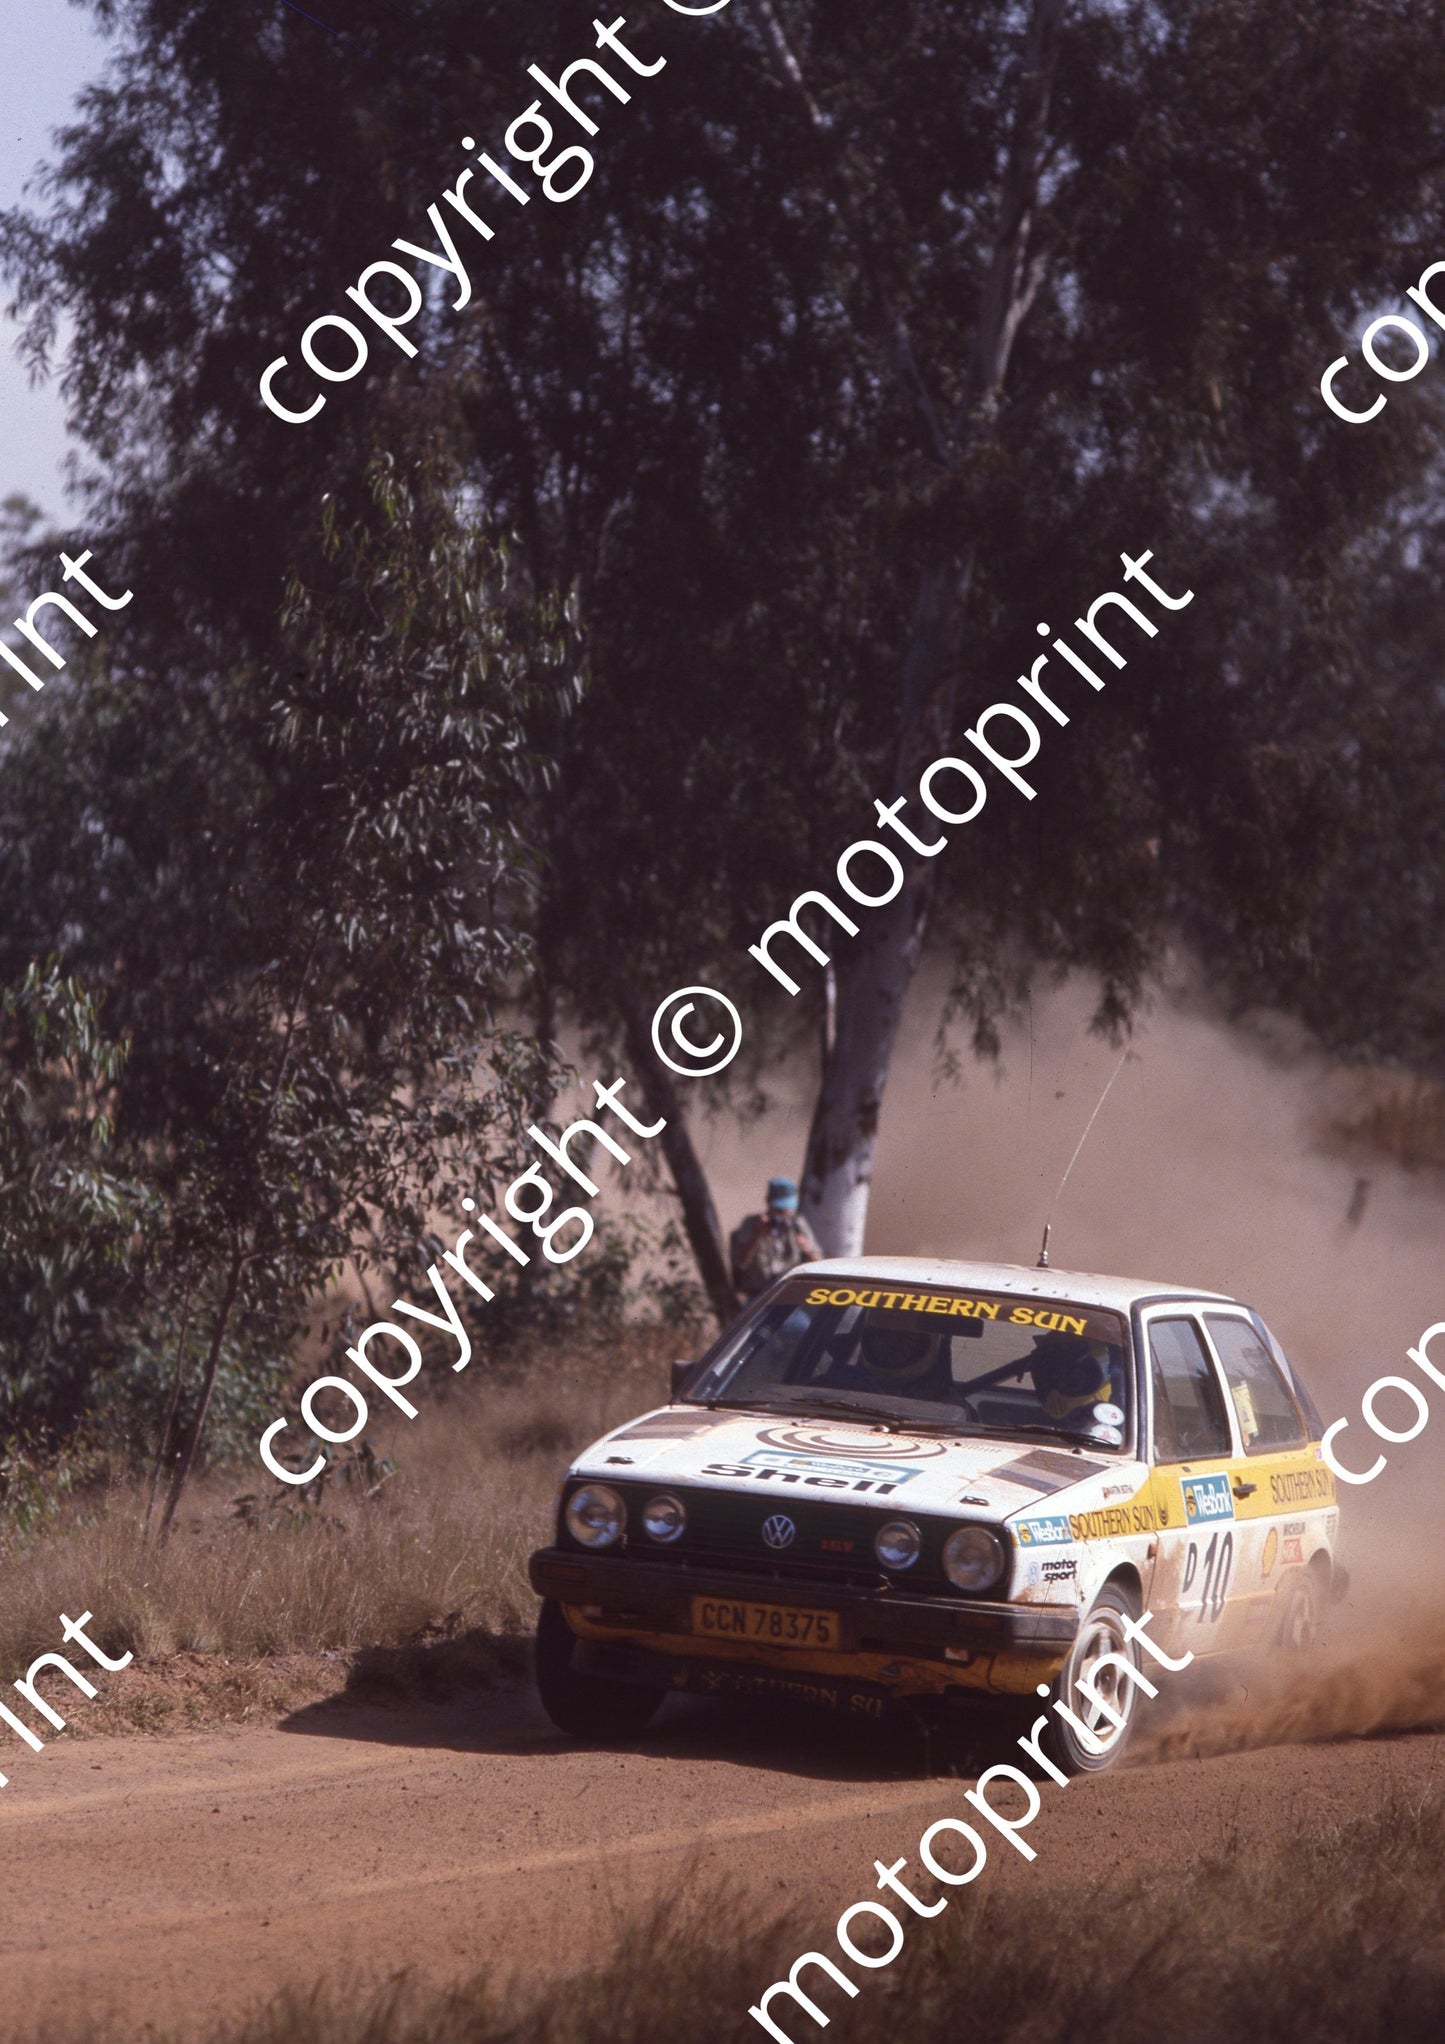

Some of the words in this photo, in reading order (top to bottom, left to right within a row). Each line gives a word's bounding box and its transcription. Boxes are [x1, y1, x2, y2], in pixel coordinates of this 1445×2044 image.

[805, 1288, 1001, 1320] SOUTHERN
[1009, 1307, 1088, 1336] SUN
[701, 1463, 898, 1495] Shell
[1270, 1470, 1316, 1504] SOUTHERN
[1192, 1480, 1233, 1518] WesBank
[1027, 1518, 1072, 1543] WesBank
[1067, 1508, 1132, 1540] SOUTHERN
[1132, 1505, 1155, 1533] SUN
[1041, 1558, 1078, 1571] motor
[1043, 1569, 1077, 1584] sport
[1197, 1531, 1234, 1624] 10
[701, 1602, 746, 1634] CCN
[753, 1608, 830, 1643] 78375
